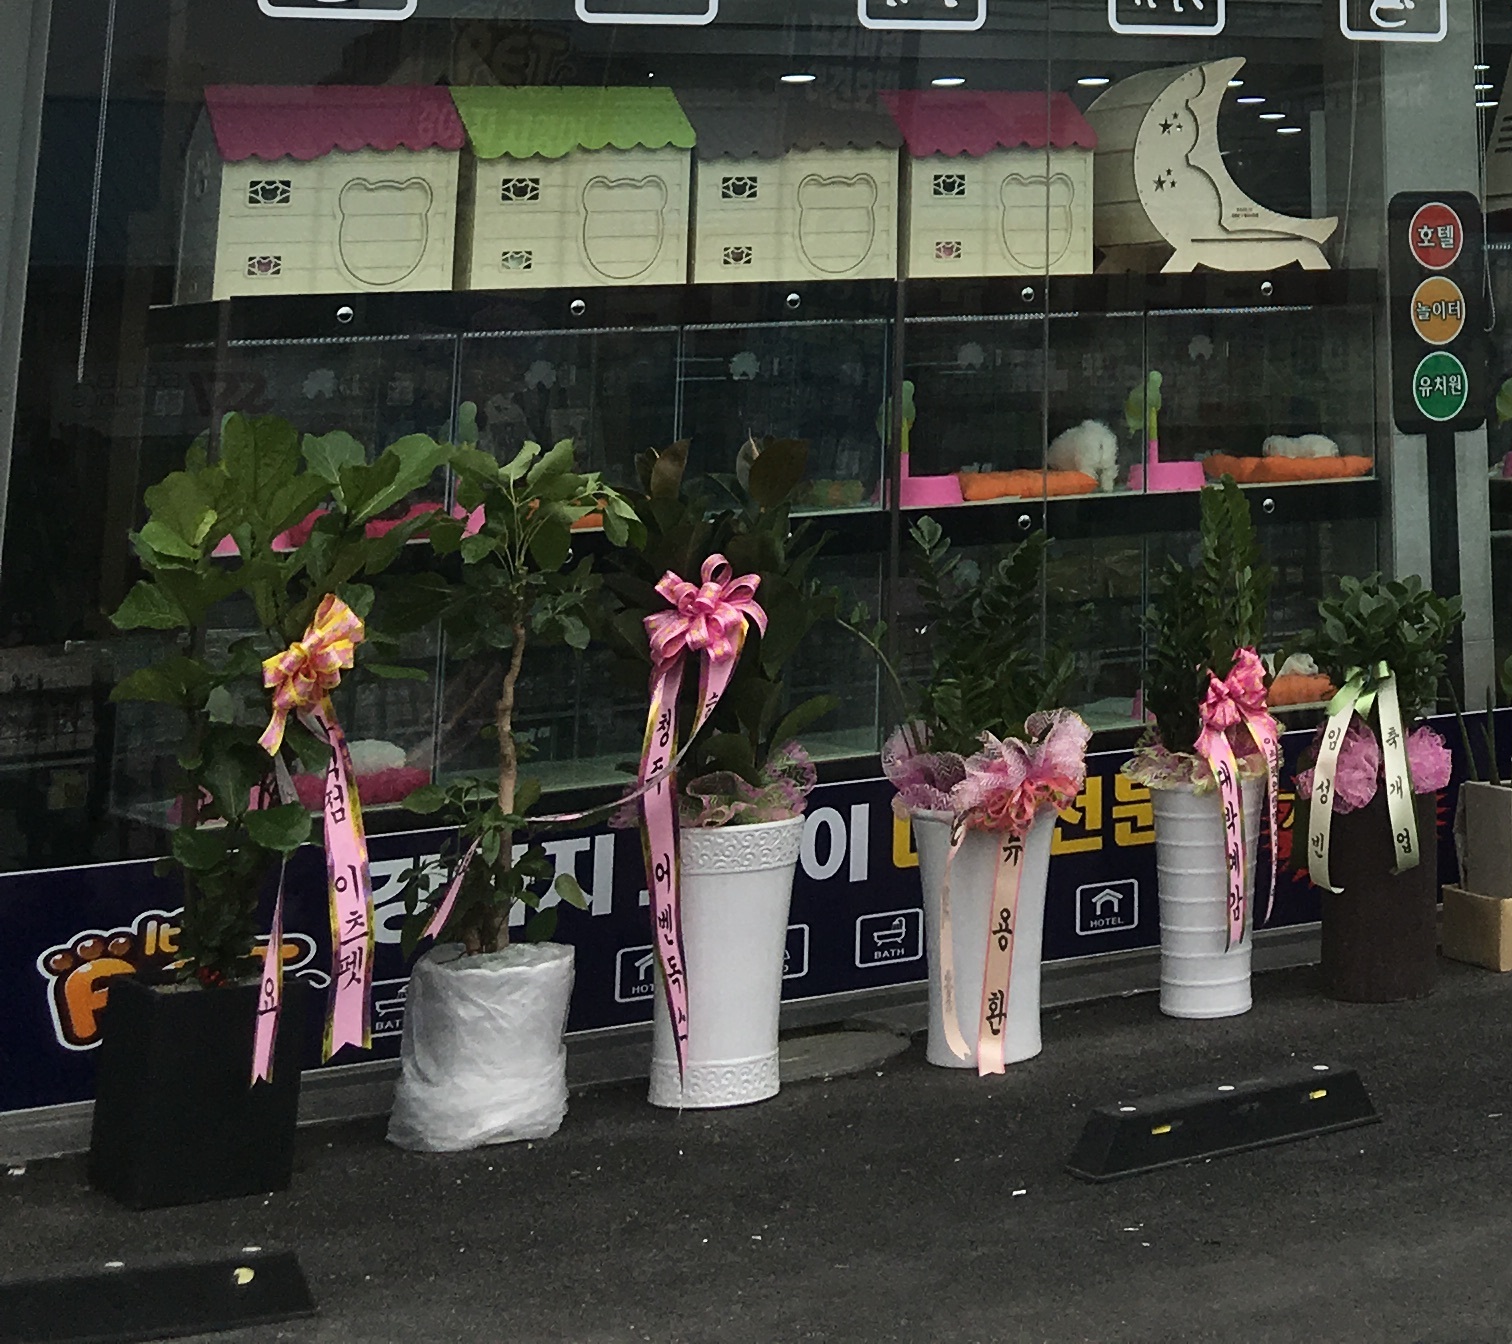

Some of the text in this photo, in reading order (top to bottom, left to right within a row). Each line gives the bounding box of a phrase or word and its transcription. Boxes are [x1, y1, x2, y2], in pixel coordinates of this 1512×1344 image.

[1417, 224, 1455, 249] 호텔
[1415, 300, 1462, 321] 놀이터
[1418, 374, 1463, 398] 유치원
[334, 864, 370, 990] 이츠펫
[1089, 916, 1125, 929] HOTEL
[873, 947, 905, 960] BATH
[631, 982, 654, 995] HOT
[374, 1019, 403, 1032] BAT
